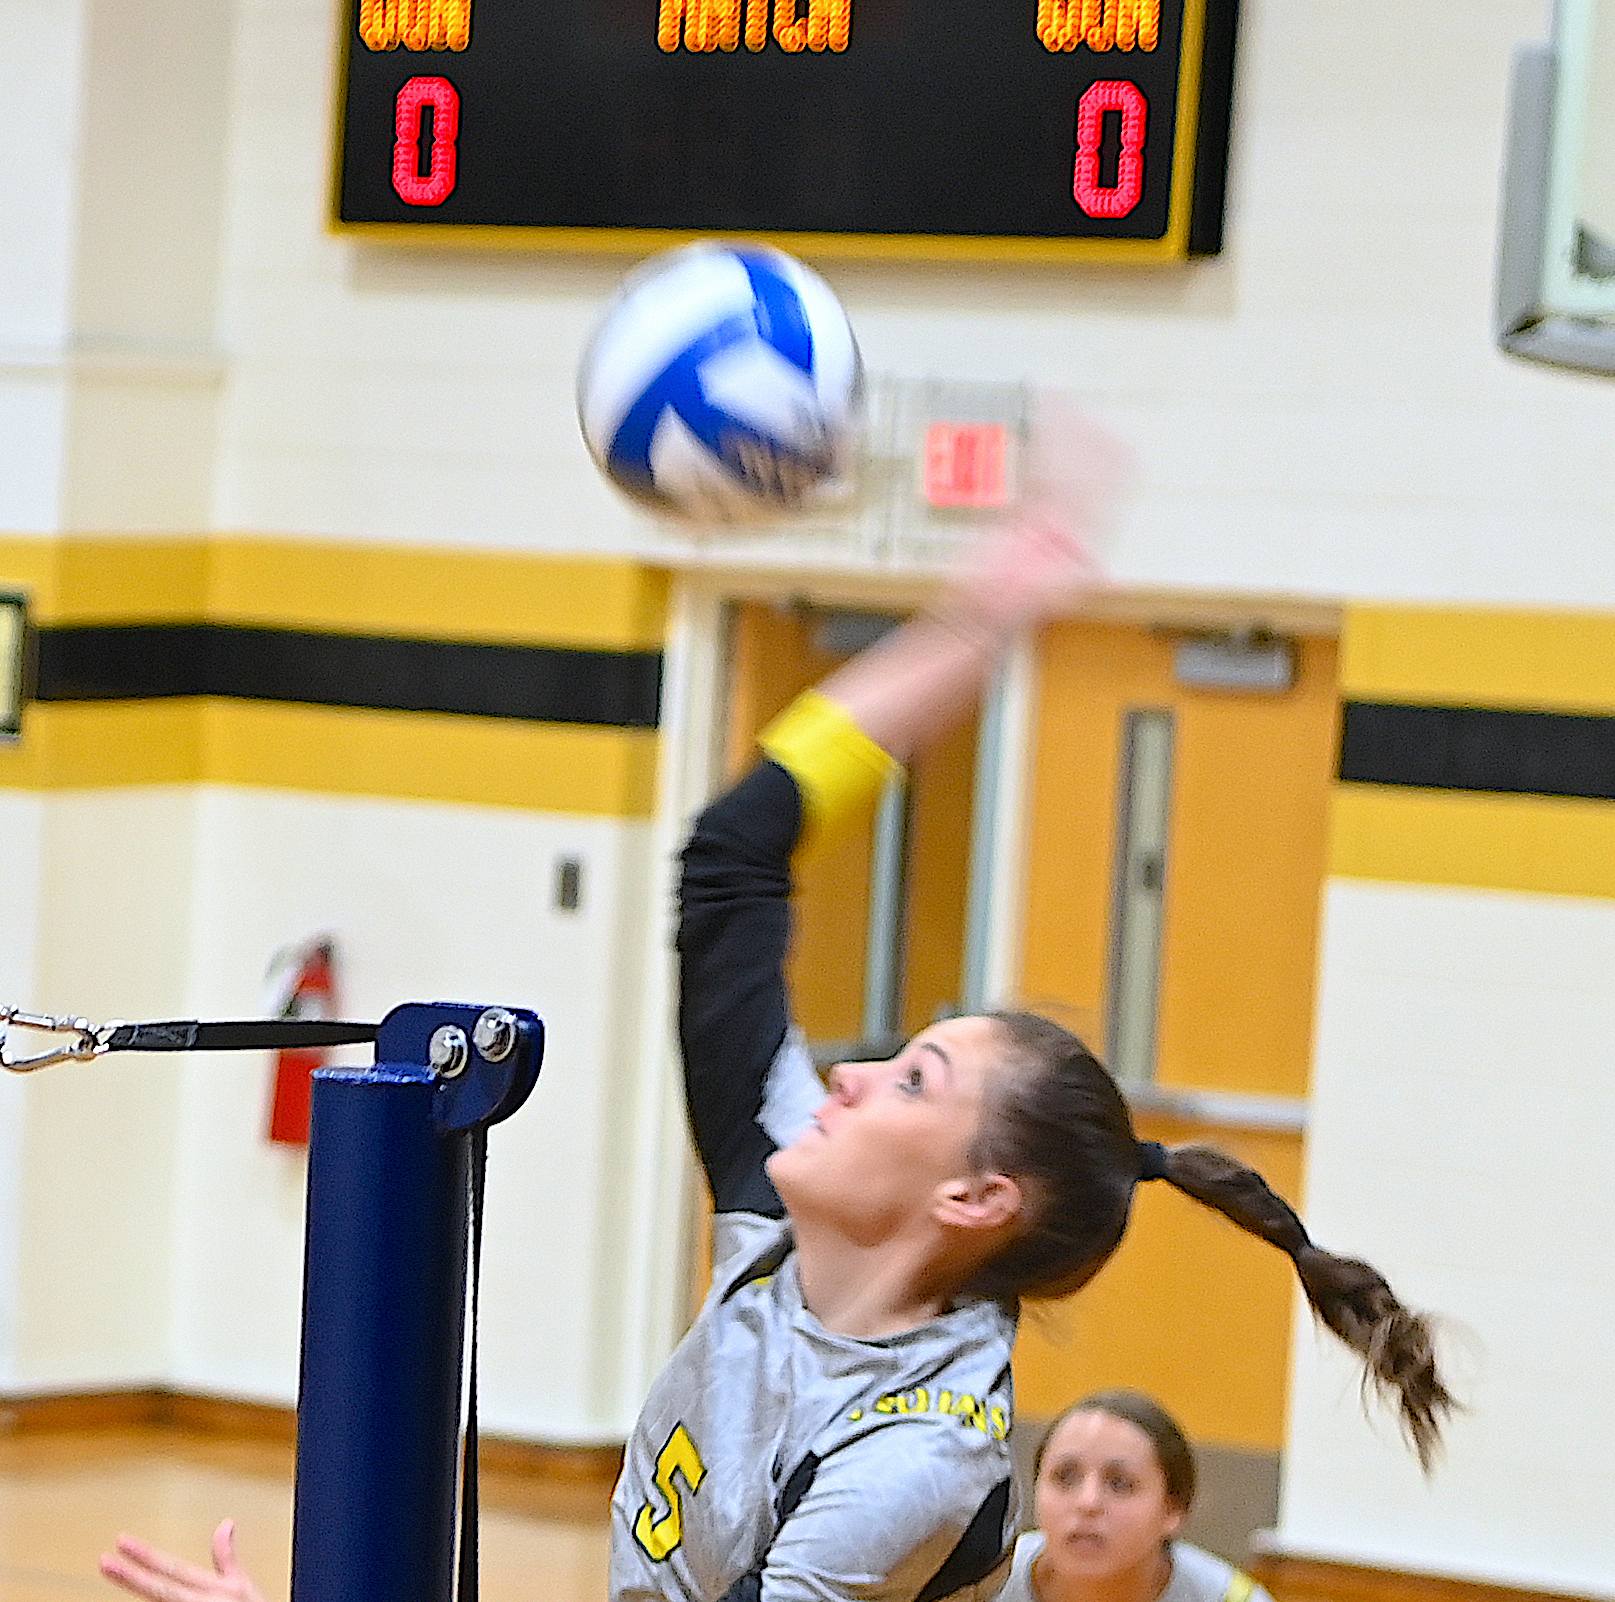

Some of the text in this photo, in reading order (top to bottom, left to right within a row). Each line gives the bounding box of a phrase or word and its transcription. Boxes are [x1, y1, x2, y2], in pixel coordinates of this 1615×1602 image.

[391, 76, 460, 206] 0
[1073, 80, 1148, 218] 0
[632, 1420, 708, 1563] 5
